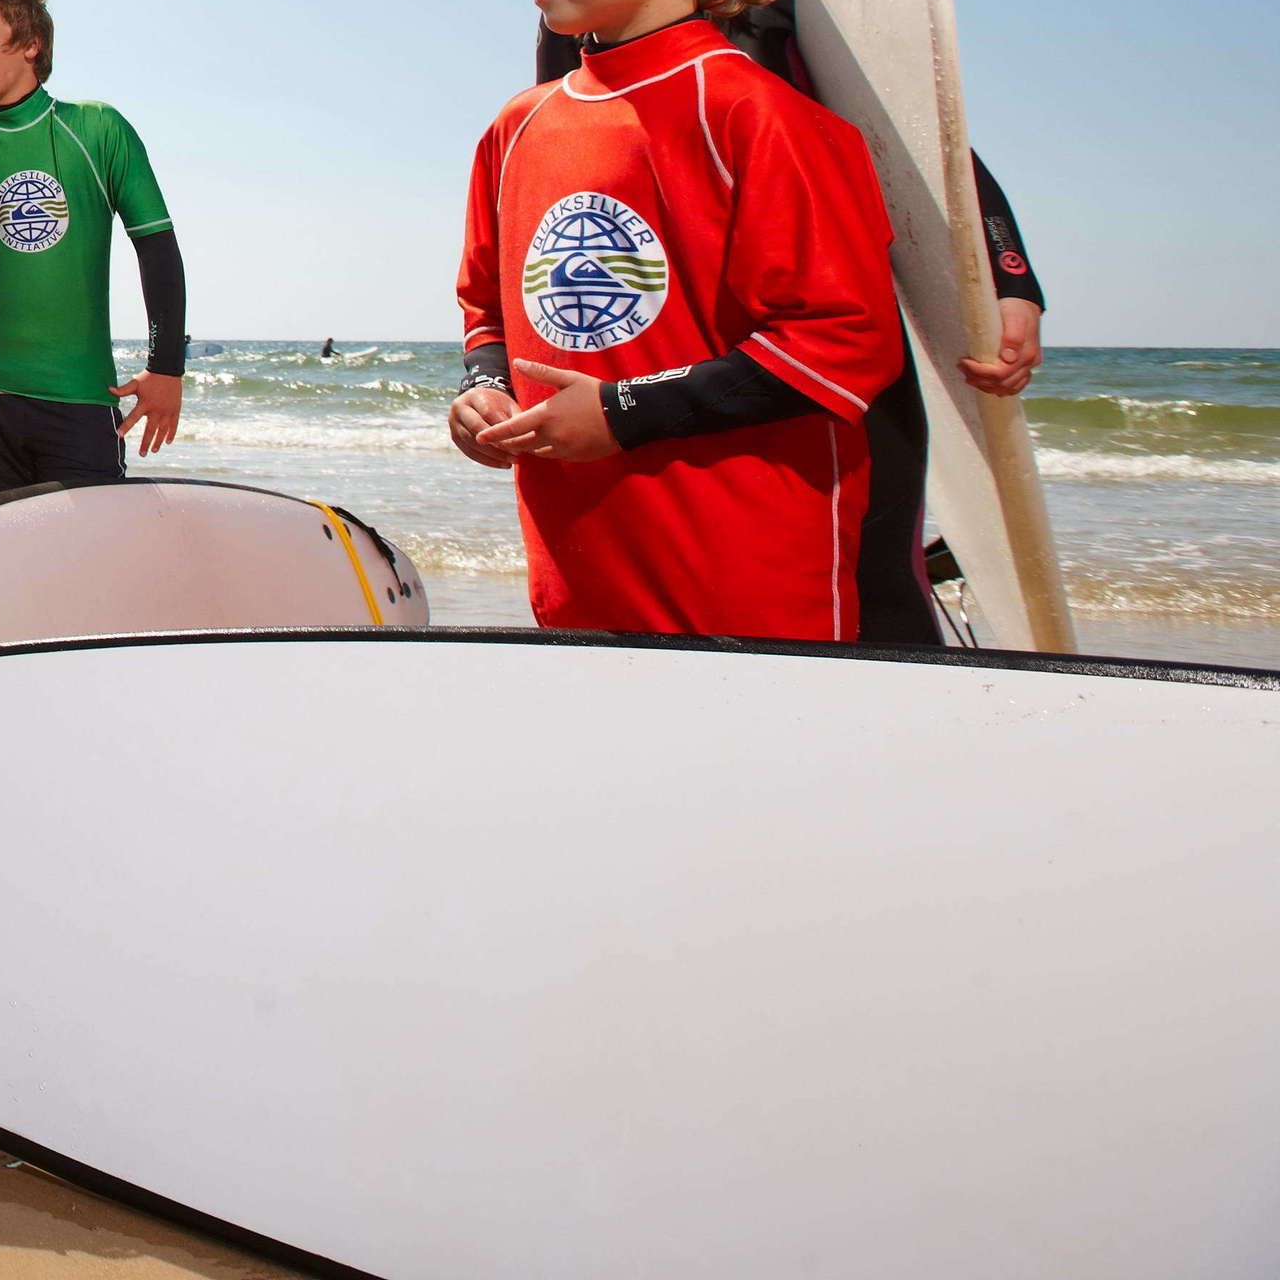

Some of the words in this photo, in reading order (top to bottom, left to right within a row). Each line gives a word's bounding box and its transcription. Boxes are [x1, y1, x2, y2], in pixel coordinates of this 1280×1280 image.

[1, 228, 64, 252] INITIATIVE
[532, 194, 656, 251] QUIKSILVER
[533, 309, 651, 350] INITIATIVE
